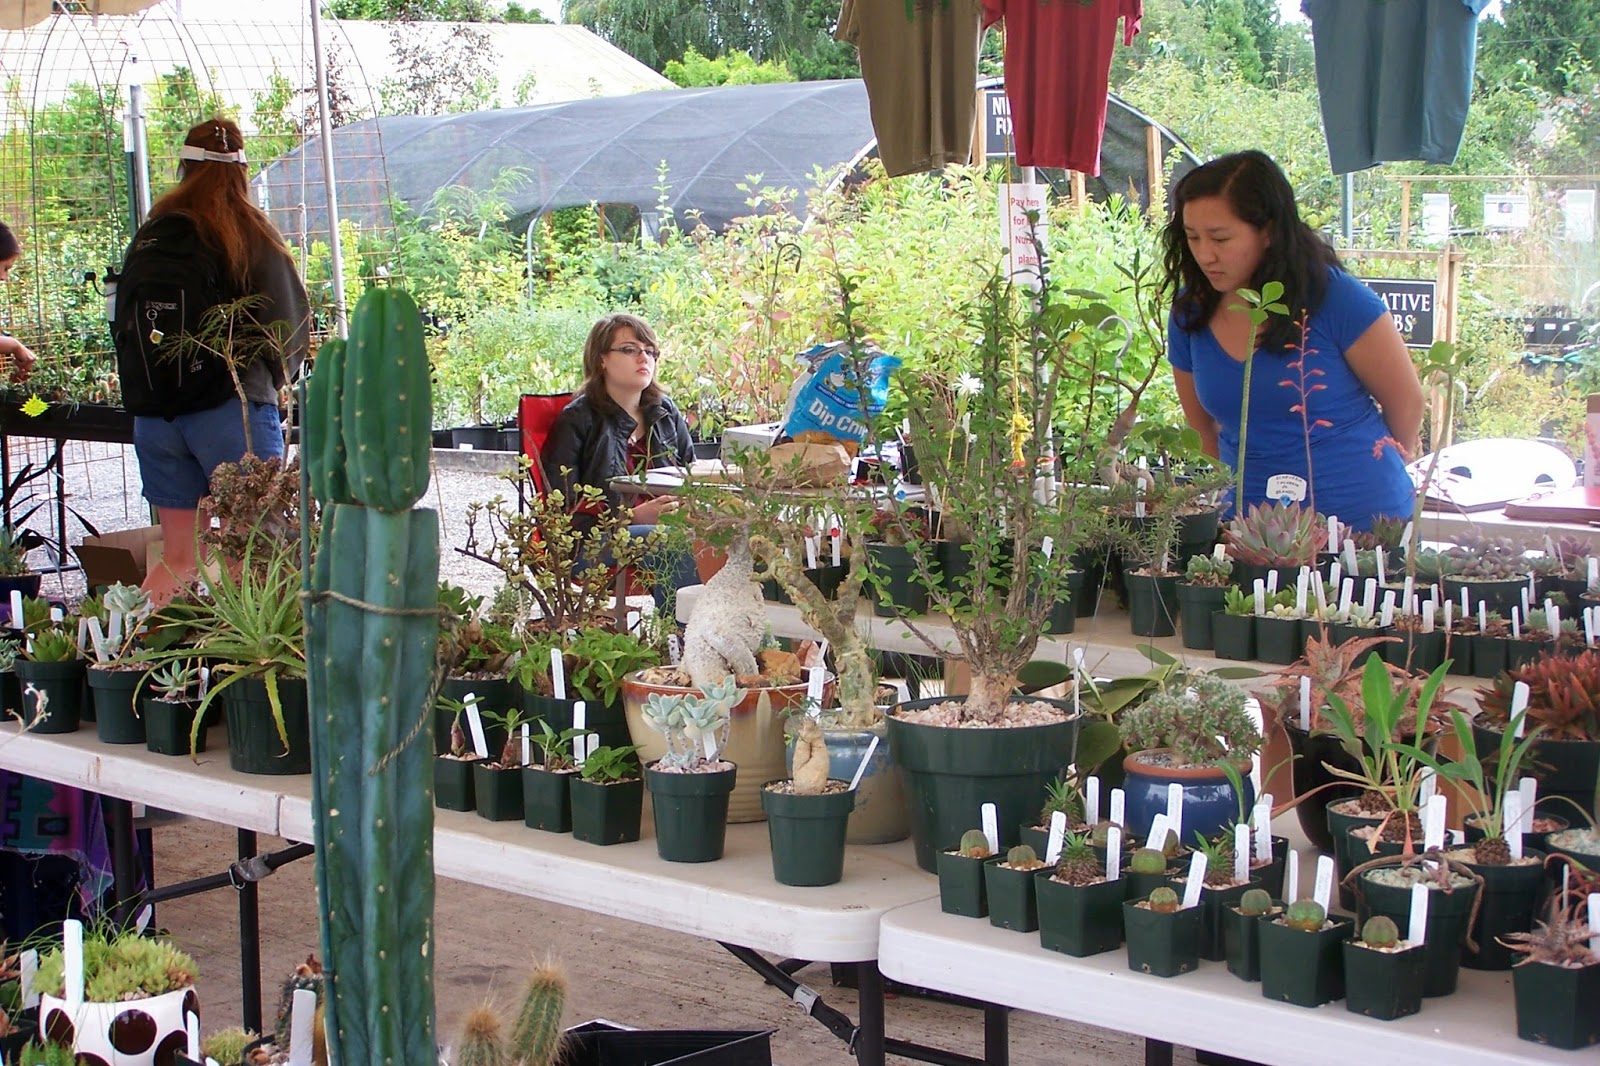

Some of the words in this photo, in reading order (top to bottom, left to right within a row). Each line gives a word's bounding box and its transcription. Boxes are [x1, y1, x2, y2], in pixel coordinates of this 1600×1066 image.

[1010, 197, 1025, 208] Pay
[1026, 196, 1040, 207] here
[1013, 215, 1025, 226] for
[1375, 292, 1431, 312] ATIVE
[809, 397, 836, 426] Dip
